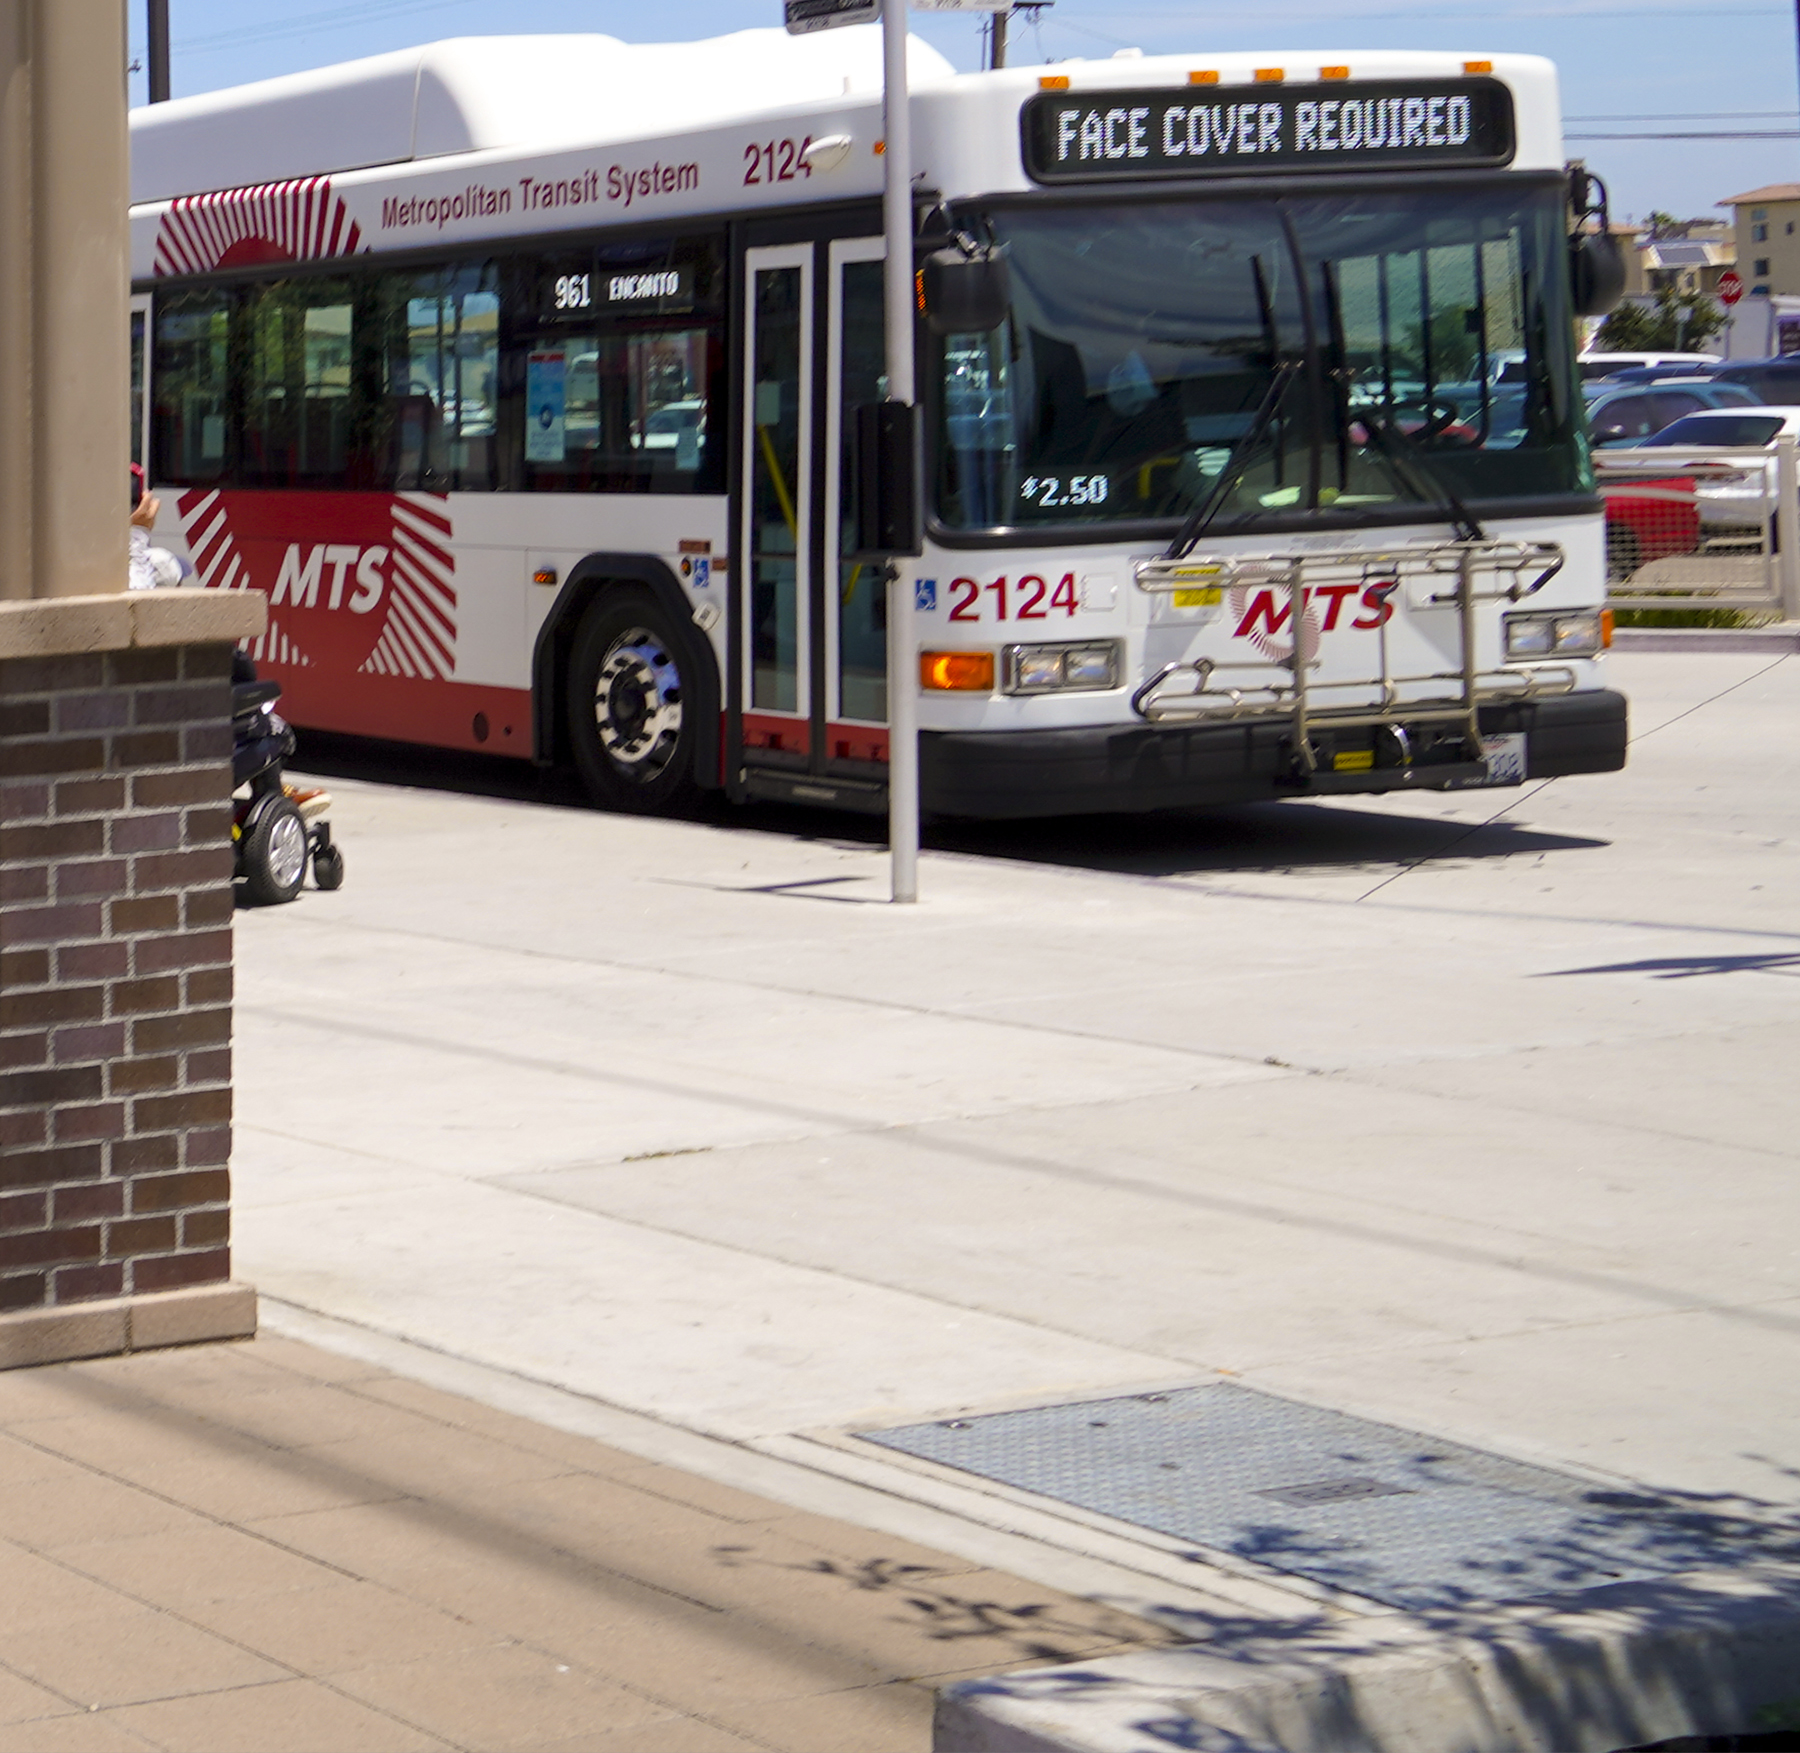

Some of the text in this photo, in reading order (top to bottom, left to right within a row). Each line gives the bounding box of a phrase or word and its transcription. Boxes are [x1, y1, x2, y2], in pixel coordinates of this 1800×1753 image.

[1058, 95, 1470, 161] FACE COVER REQUIRED
[743, 135, 813, 187] 2124
[381, 160, 699, 230] Metropolitan Transit System
[554, 271, 680, 310] 961 ENCANTO
[1020, 474, 1108, 507] $2.50
[269, 542, 390, 614] MTS
[948, 572, 1079, 623] 2124
[1233, 581, 1400, 639] MTS
